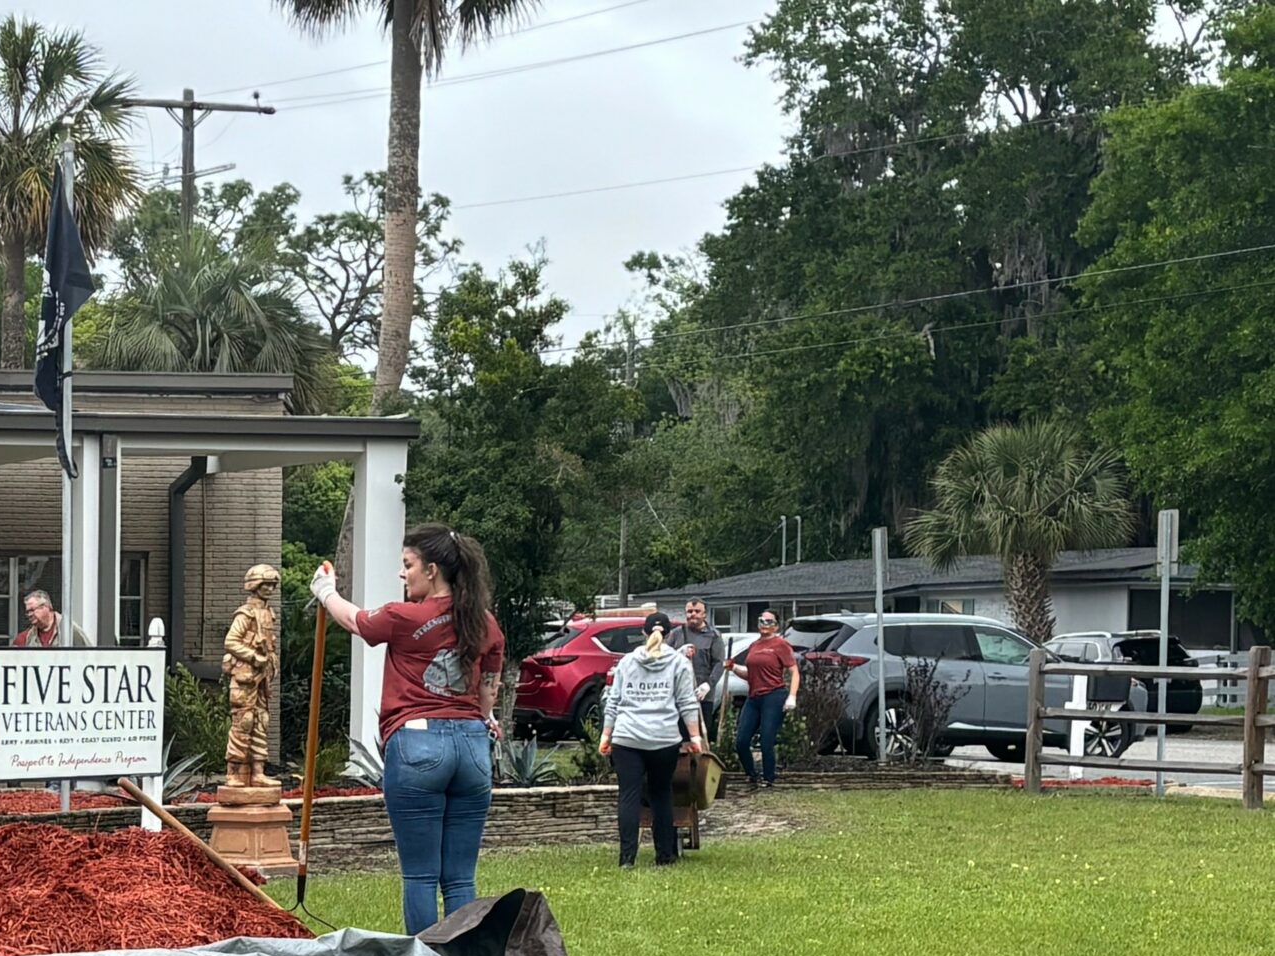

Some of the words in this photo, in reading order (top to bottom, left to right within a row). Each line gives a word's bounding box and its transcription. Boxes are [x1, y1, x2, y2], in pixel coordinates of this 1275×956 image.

[1, 665, 72, 705] FIVE
[82, 664, 157, 704] STAR
[1, 711, 87, 733] VETERANS
[92, 709, 157, 731] CENTER
[47, 755, 55, 766] to
[58, 752, 112, 771] Independence
[115, 750, 148, 769] Program
